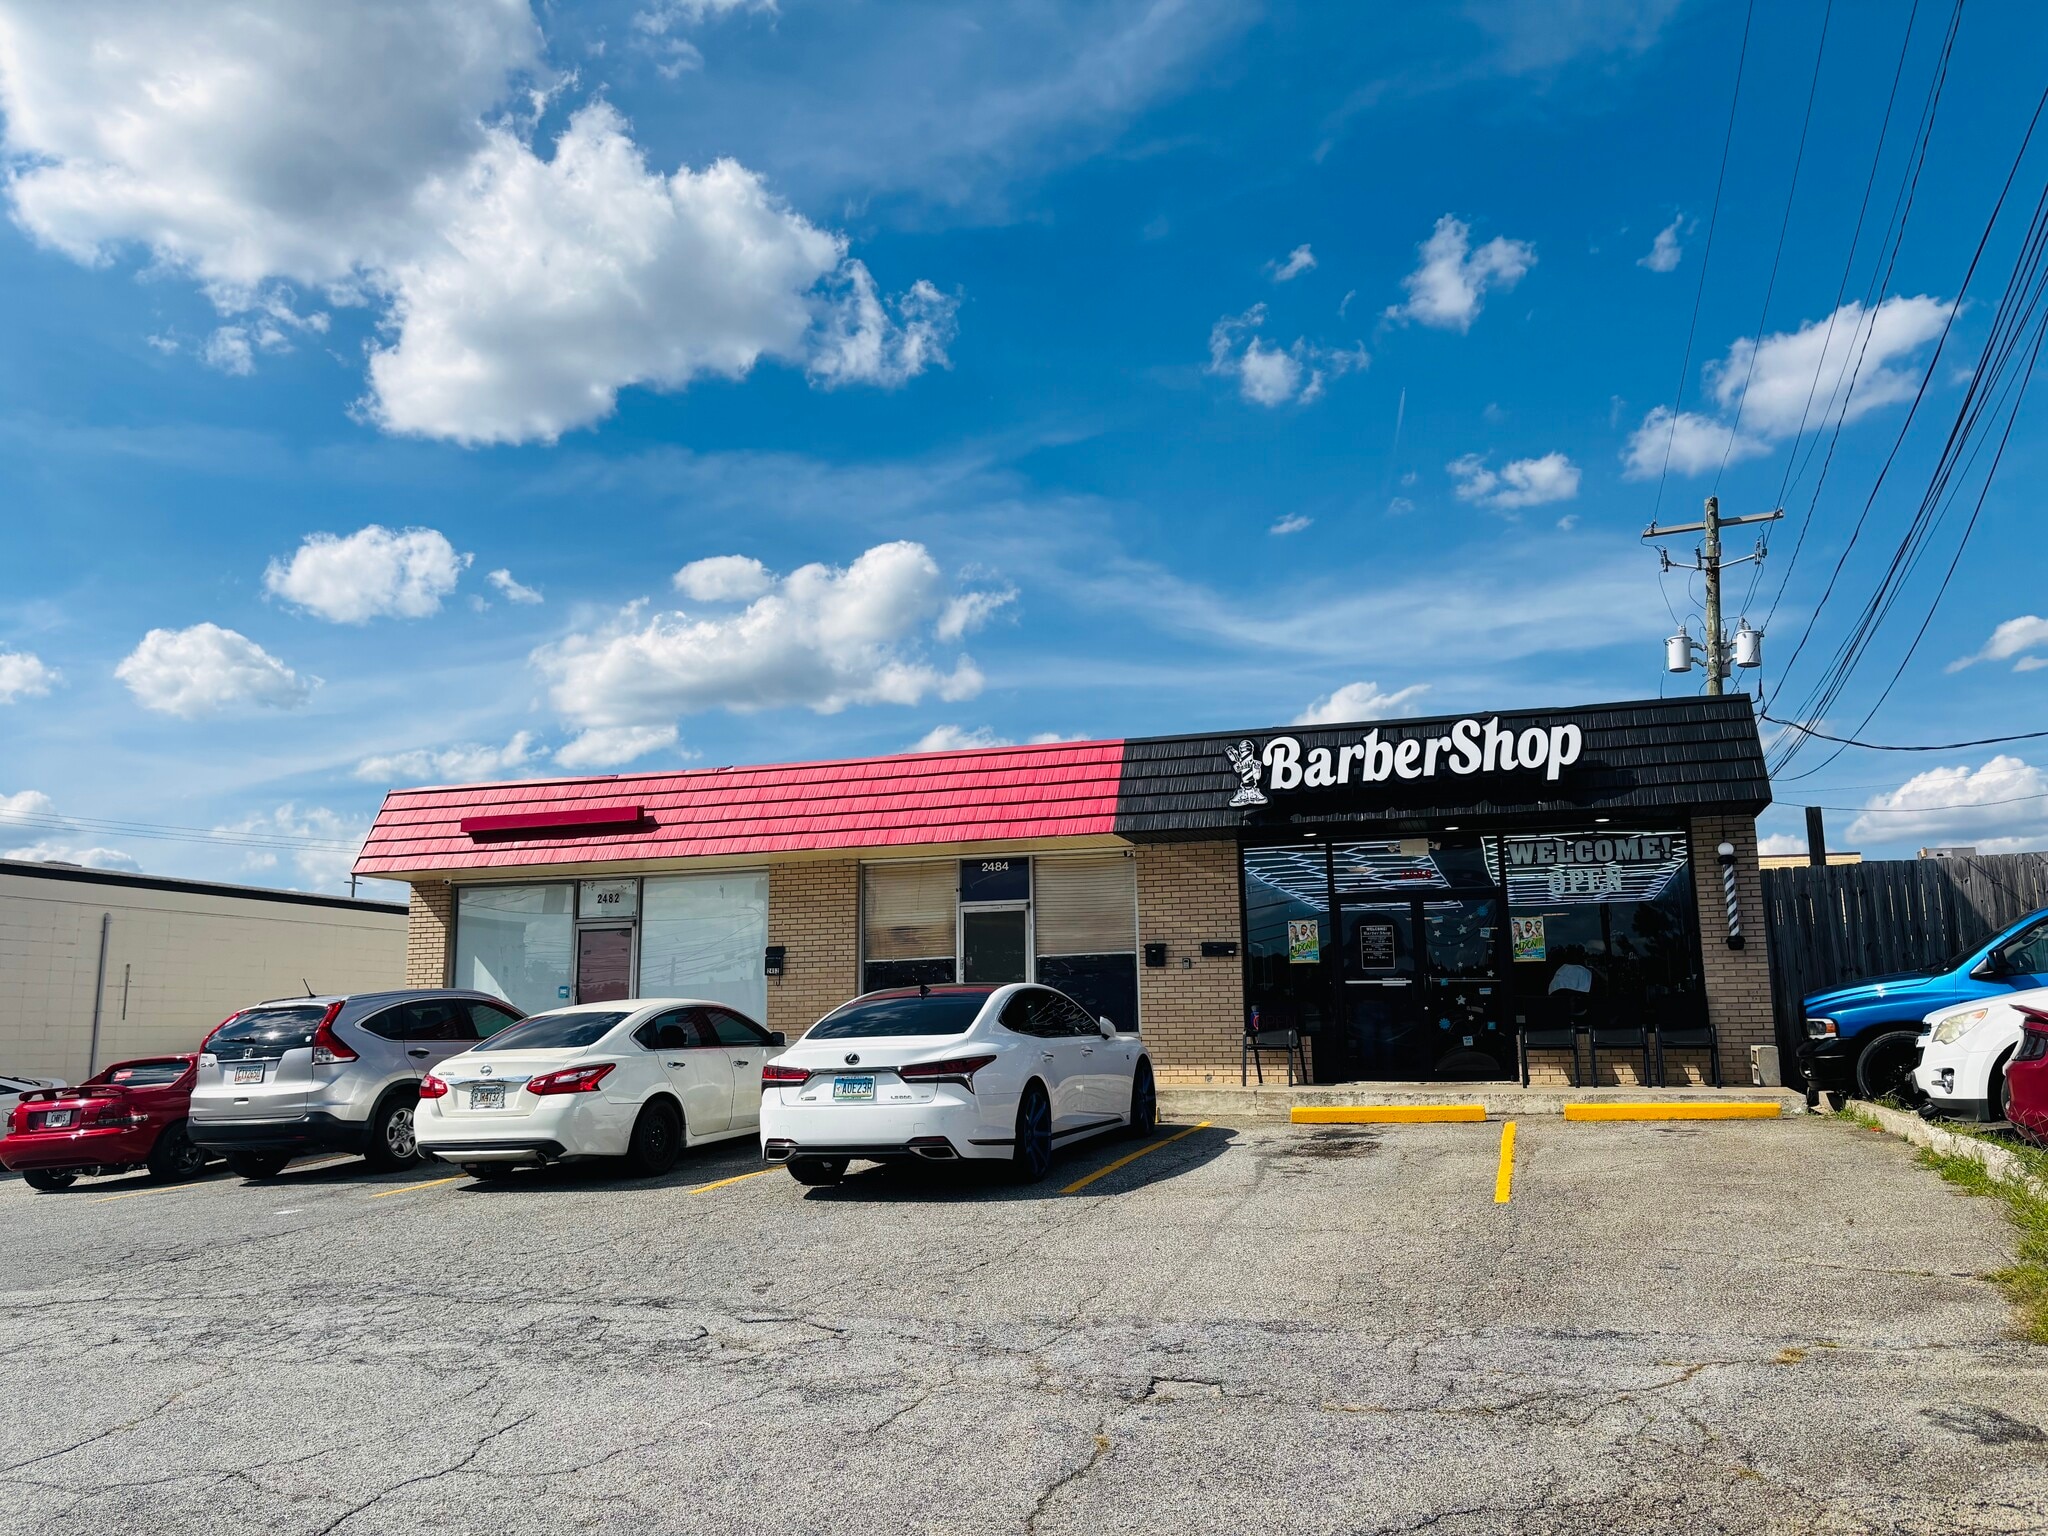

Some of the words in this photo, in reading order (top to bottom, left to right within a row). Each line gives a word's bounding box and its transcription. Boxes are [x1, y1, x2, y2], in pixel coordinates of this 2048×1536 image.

[1262, 716, 1582, 790] BarberShop
[1508, 836, 1673, 865] WELCOME!
[981, 861, 1009, 872] 2484
[1550, 867, 1623, 895] OPEN
[597, 893, 620, 904] 2482
